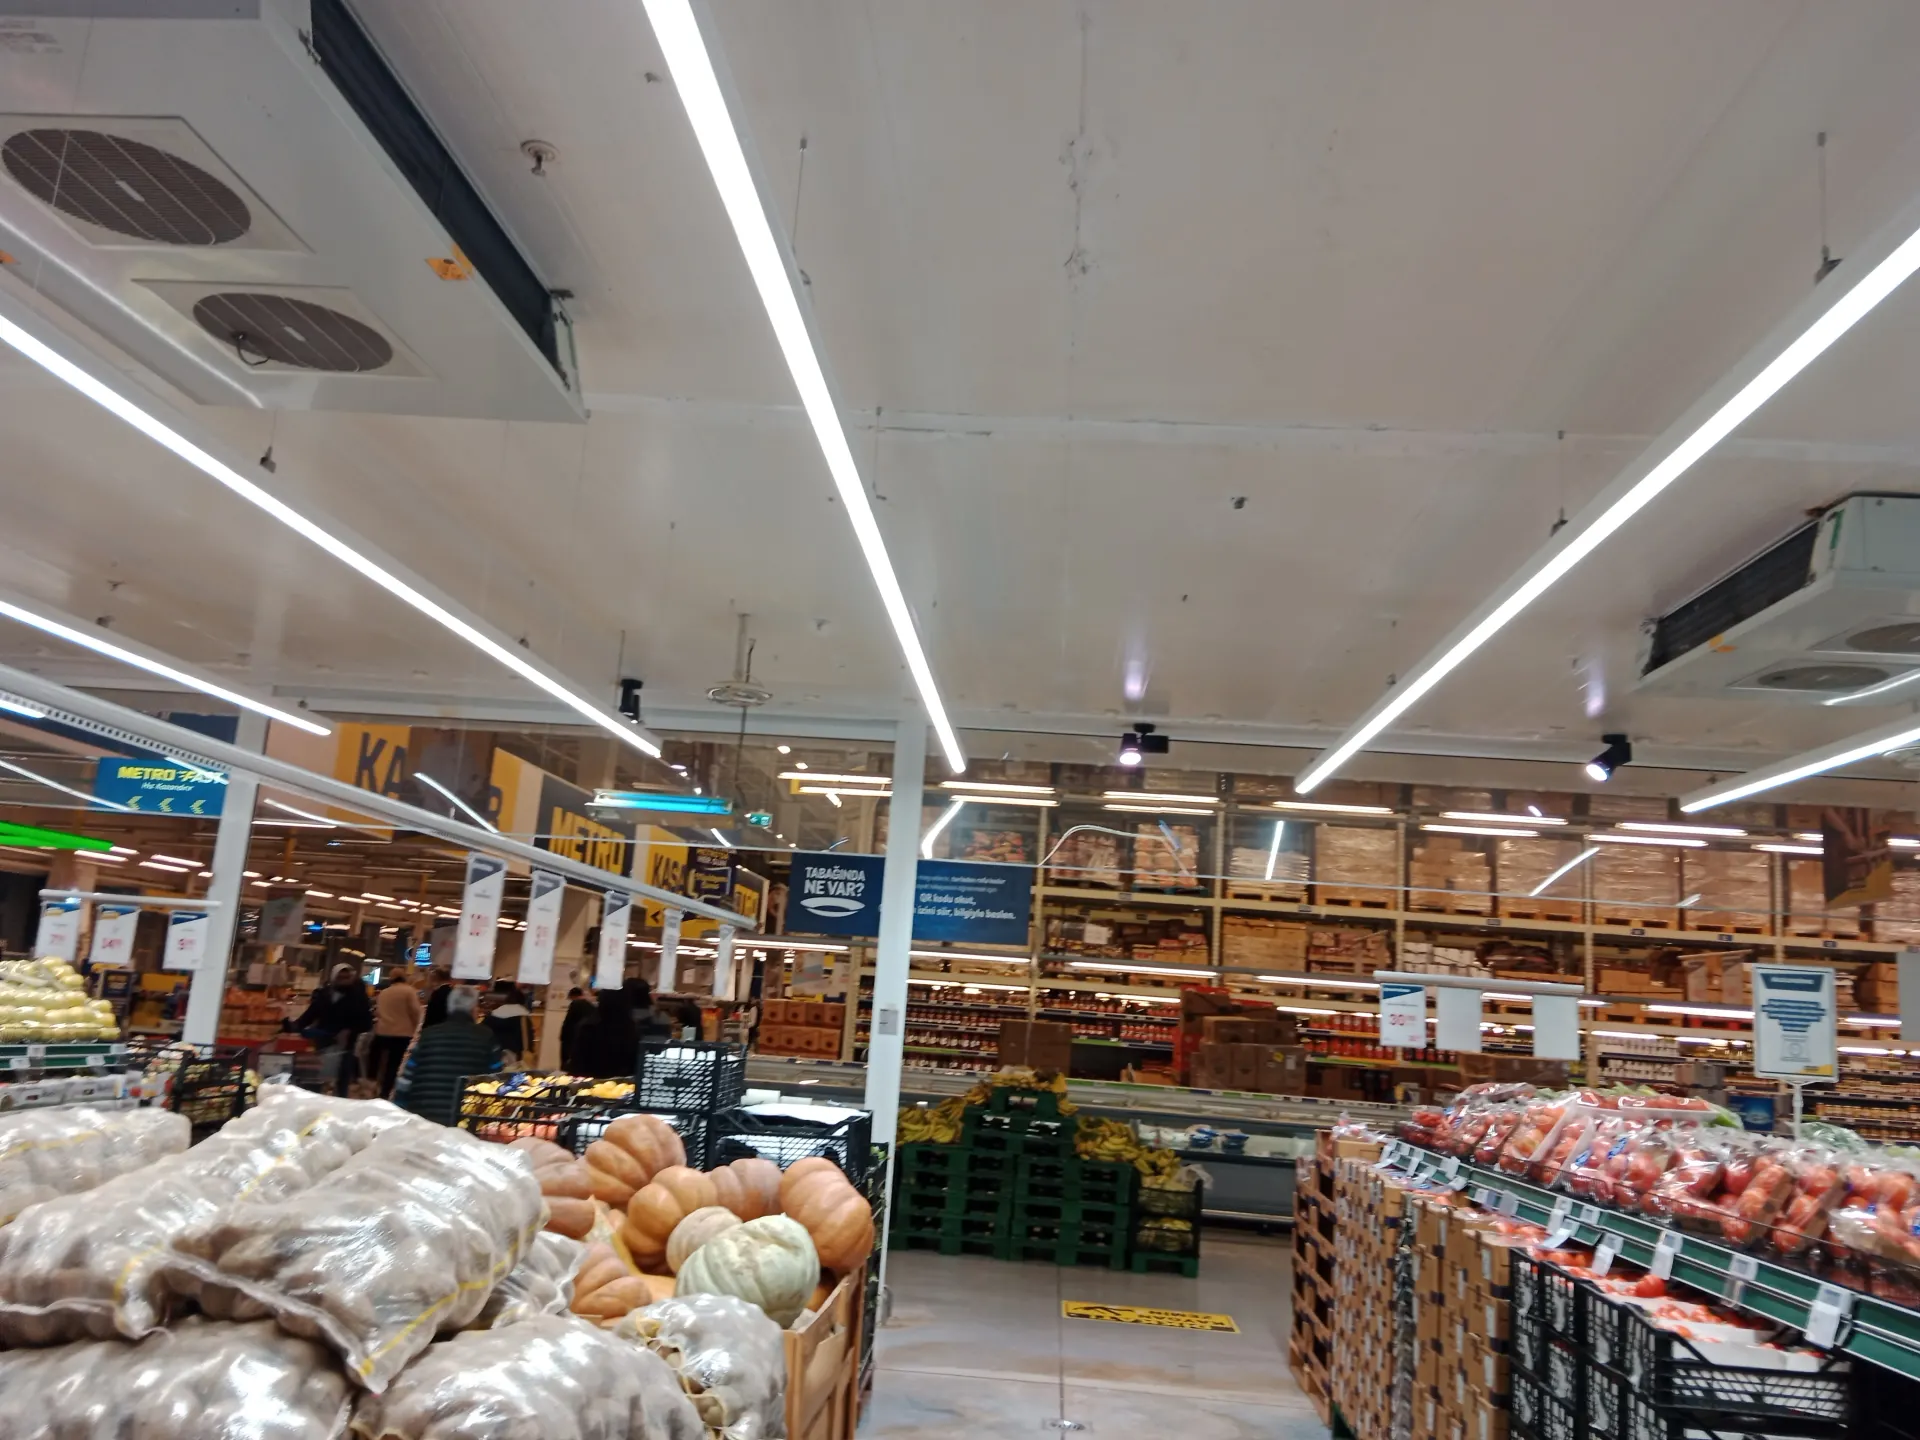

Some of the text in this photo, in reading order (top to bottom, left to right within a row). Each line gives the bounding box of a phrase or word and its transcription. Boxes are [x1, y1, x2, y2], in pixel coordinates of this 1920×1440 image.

[117, 766, 176, 781] METRO
[548, 806, 626, 876] METRO
[805, 865, 866, 881] TABAĞINDA
[804, 879, 865, 897] NE VAR?
